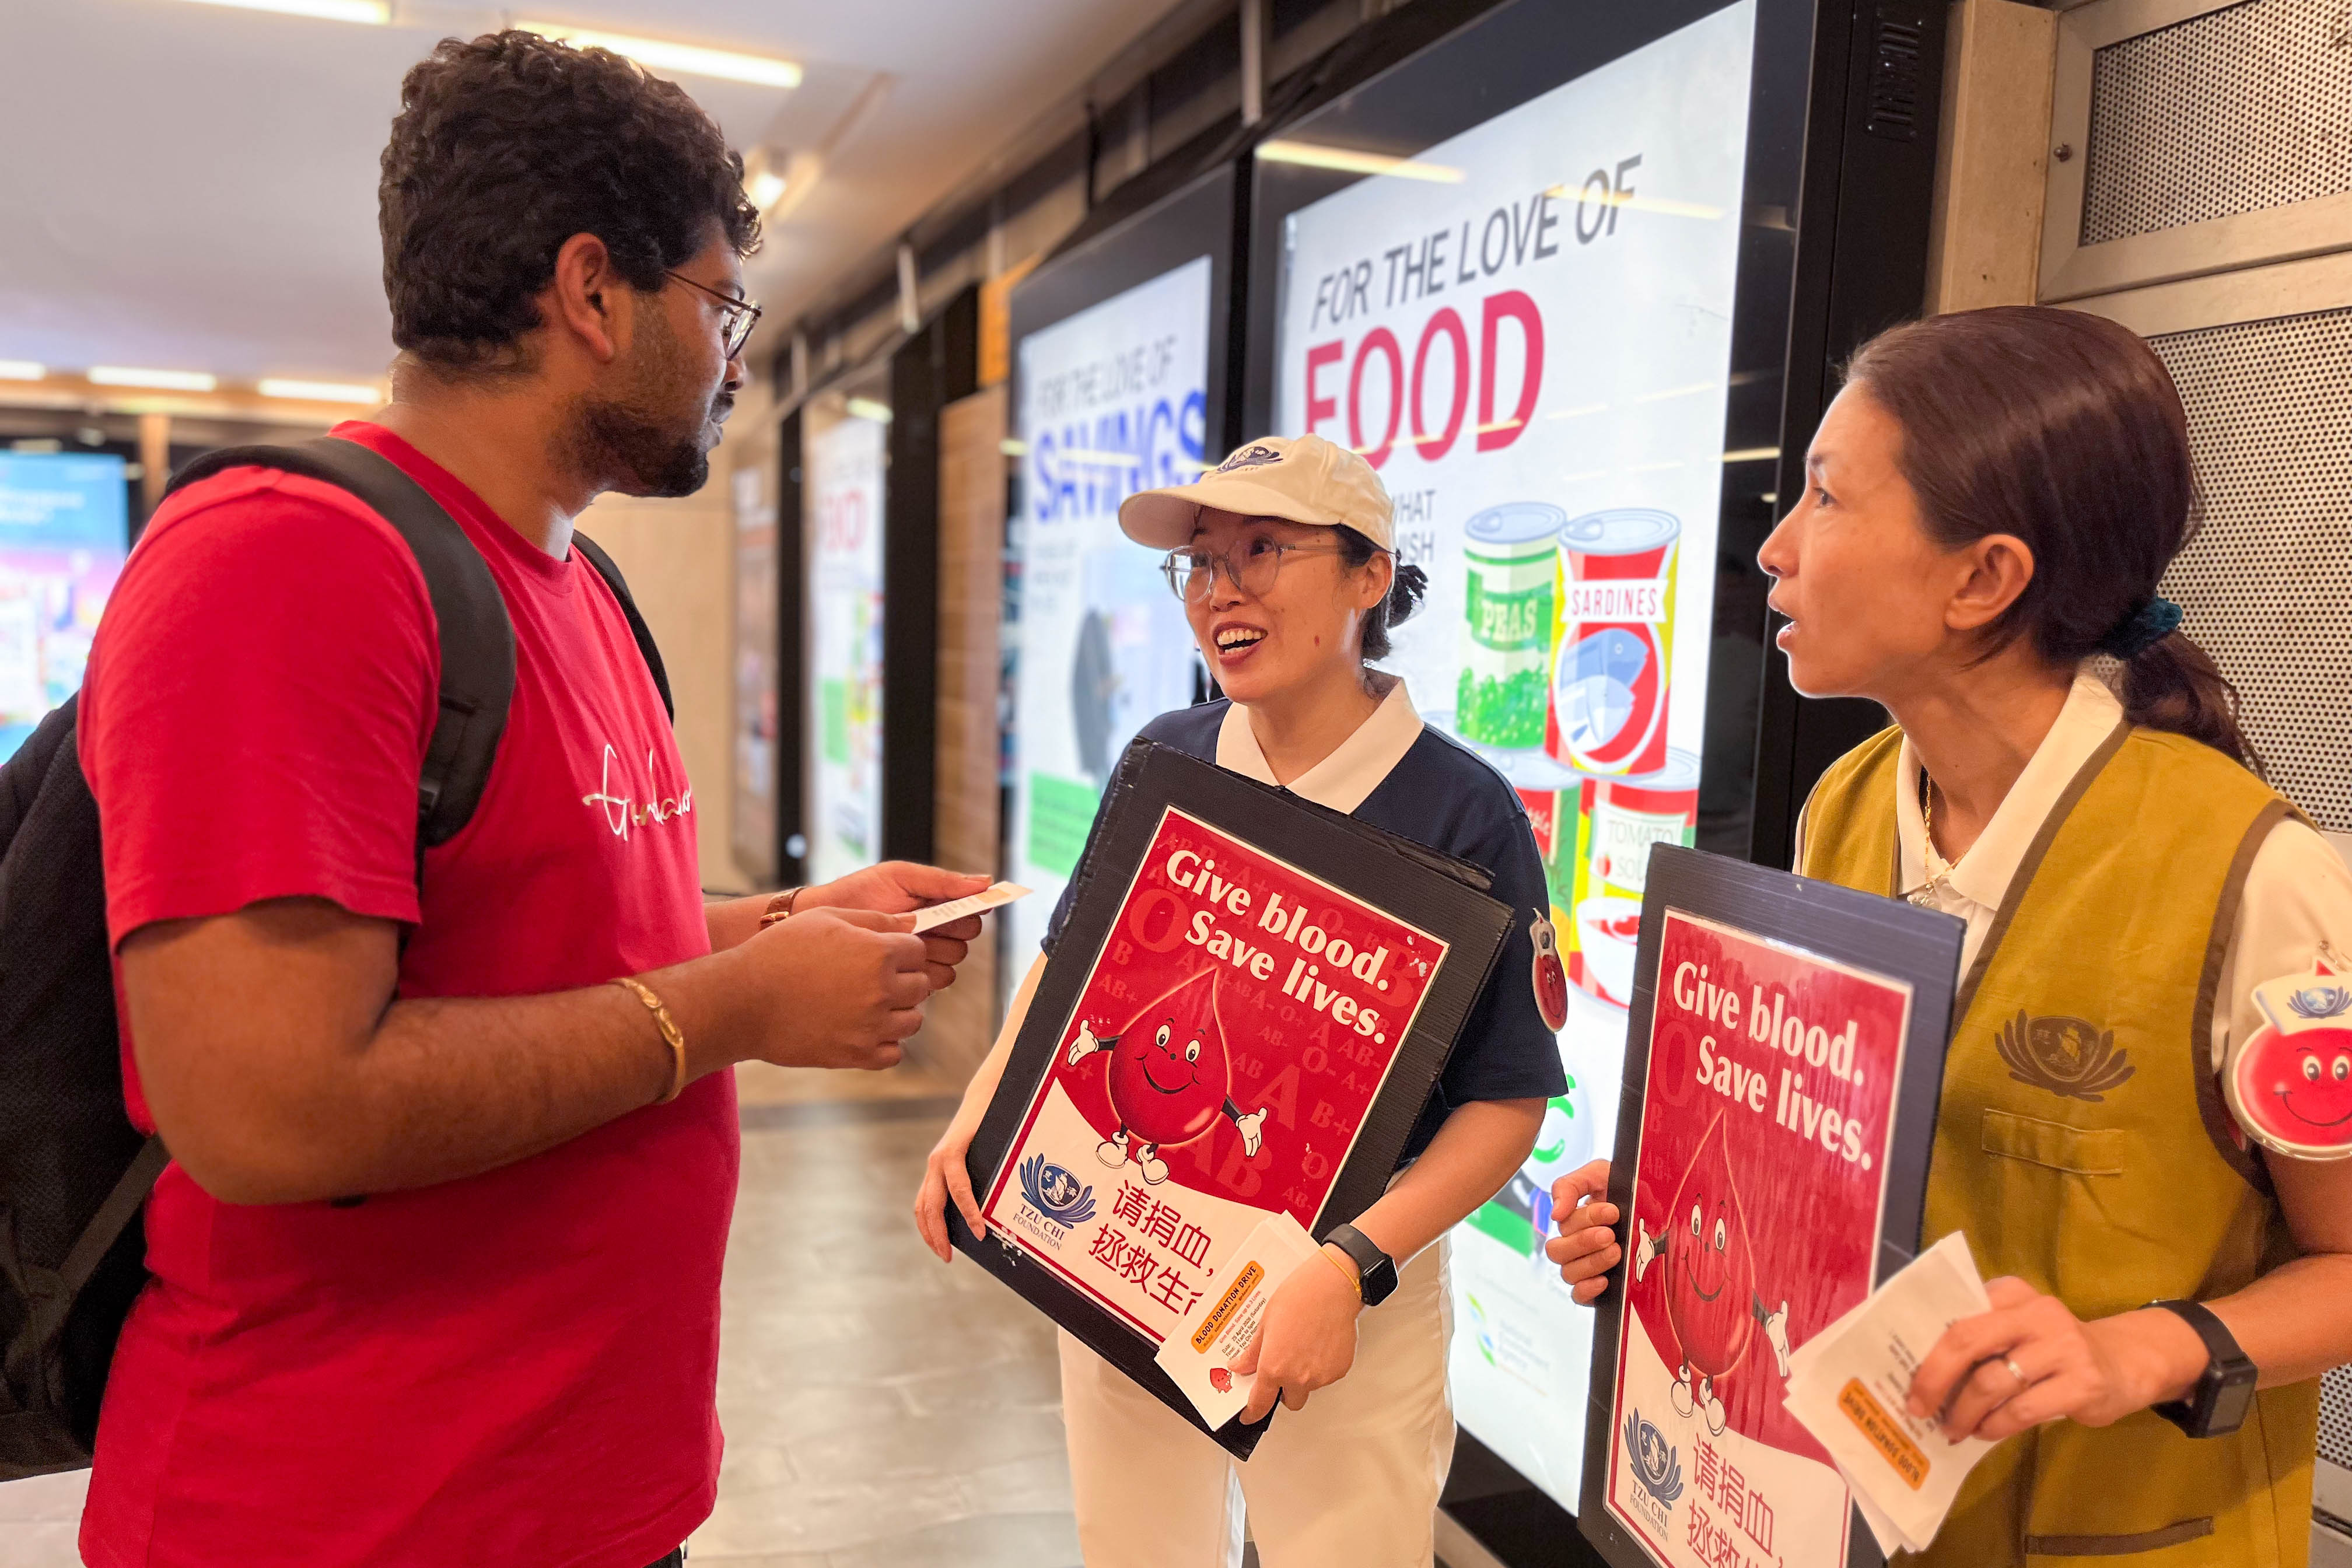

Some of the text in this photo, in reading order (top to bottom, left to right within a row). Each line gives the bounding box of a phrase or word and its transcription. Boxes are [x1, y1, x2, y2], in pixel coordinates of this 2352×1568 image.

[1310, 154, 1643, 332] FOR THE LOVE OF
[1304, 289, 1544, 473] FOOD
[1482, 600, 1538, 640] PEAS
[1572, 587, 1658, 617] SARDINES
[1607, 819, 1673, 845] TOMATO
[1166, 849, 1388, 991] Give blood.
[1184, 910, 1386, 1045] Save lives.
[1673, 961, 1864, 1087] Give blood.
[1696, 1035, 1873, 1171] Save lives.
[1013, 1213, 1062, 1251] FOUNDATION
[1020, 1203, 1065, 1241] TZU CHI
[1195, 1321, 1214, 1345] BLOOD
[1212, 1287, 1240, 1322] DONATION
[1238, 1265, 1256, 1288] DRIVE
[1630, 1493, 1668, 1542] FOUNDATION
[1632, 1479, 1668, 1528] TZU CHI
[1687, 1498, 1758, 1568] 拯救
